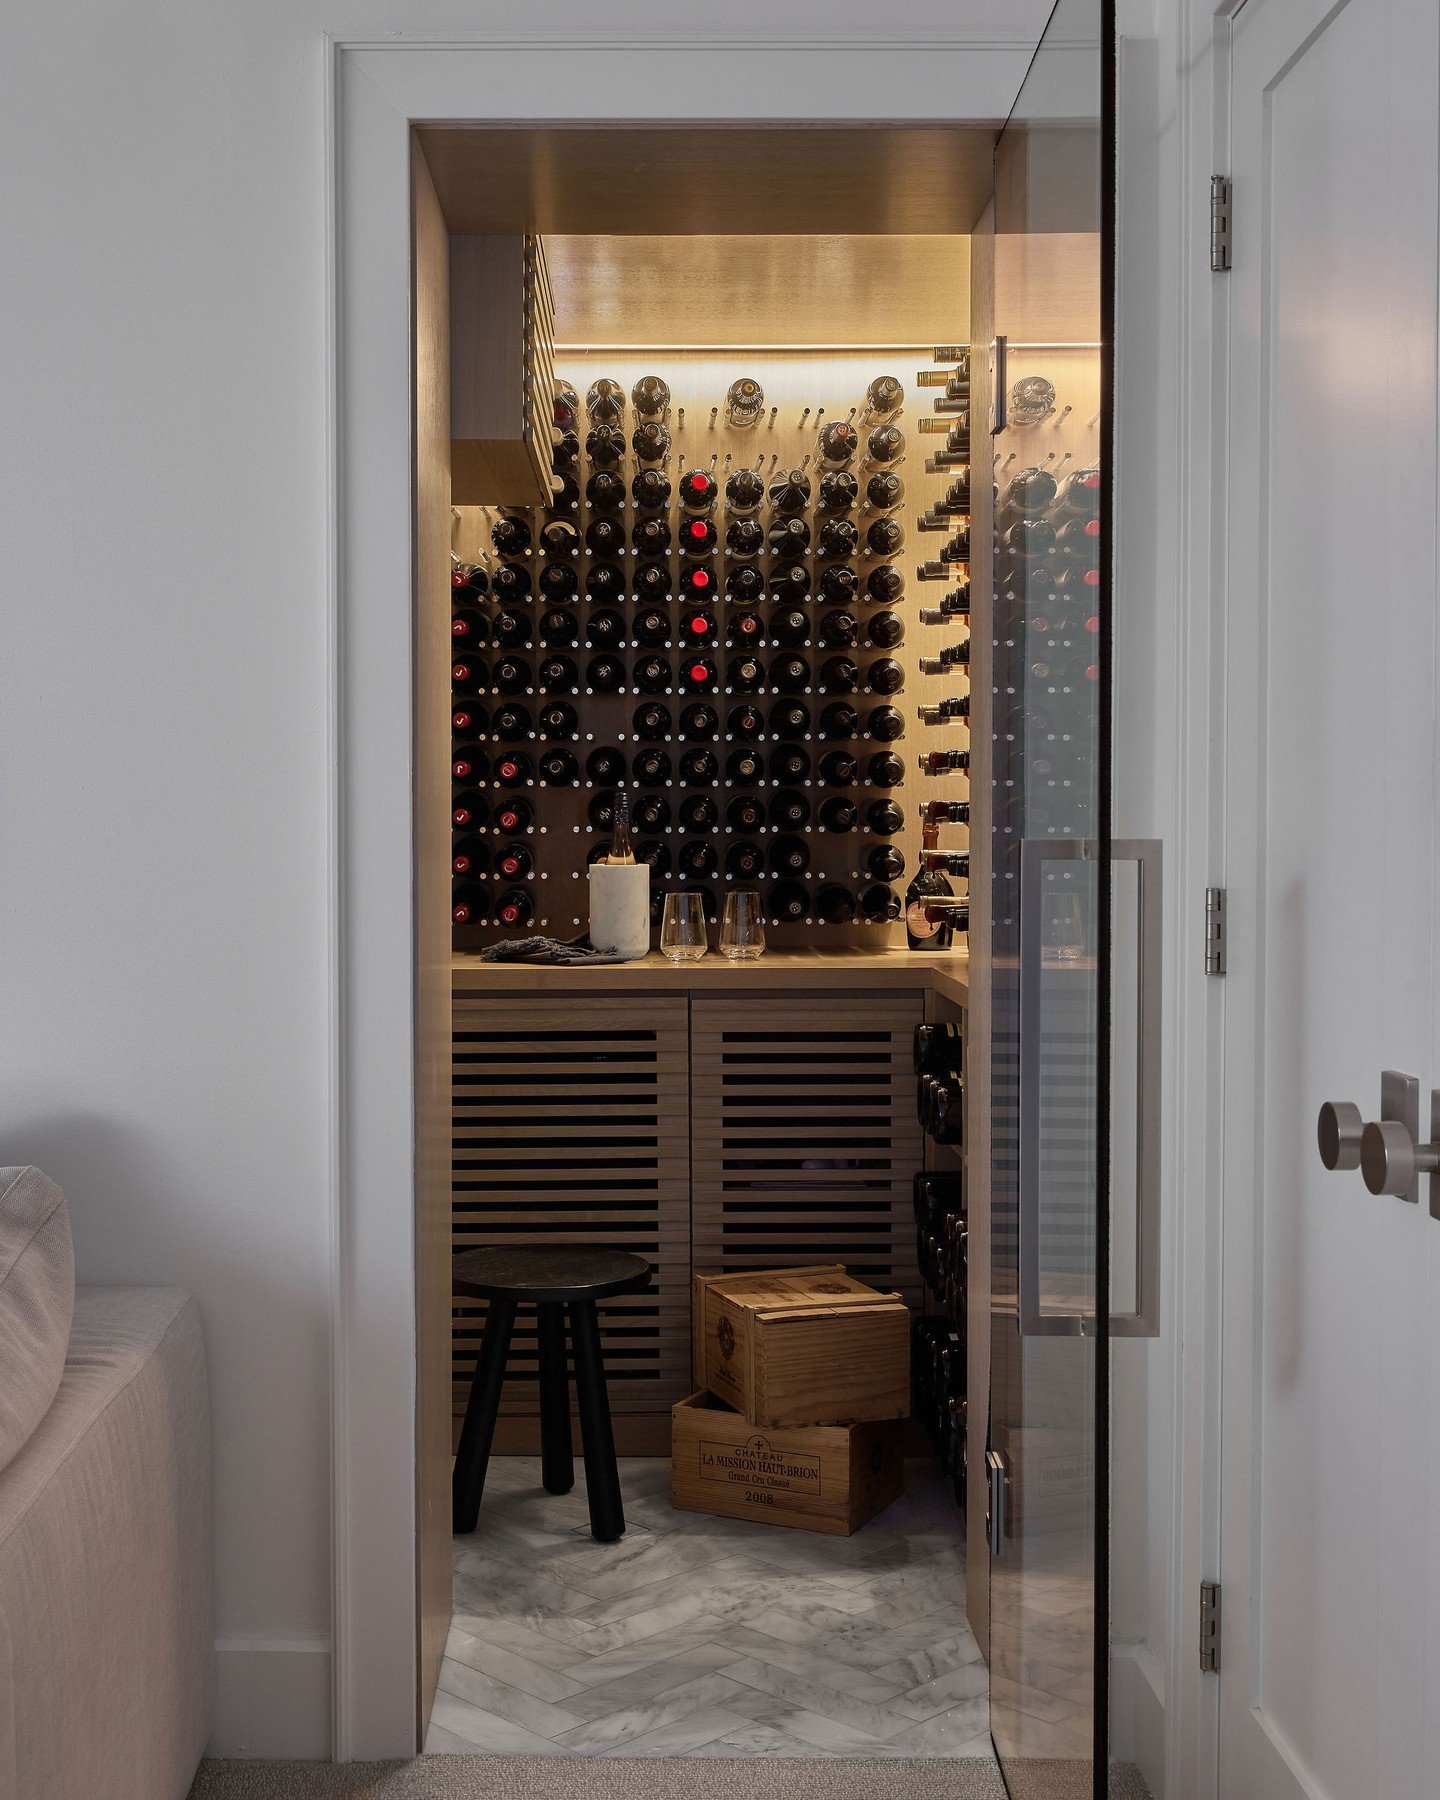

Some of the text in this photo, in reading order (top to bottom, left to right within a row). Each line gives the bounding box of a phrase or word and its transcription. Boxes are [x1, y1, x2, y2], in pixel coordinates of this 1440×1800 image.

[702, 1453, 714, 1465] LA
[716, 1455, 756, 1471] MISSION
[735, 1448, 783, 1461] CHATEAU
[728, 1470, 790, 1488] Grand Cru Classé
[745, 1491, 774, 1505] 2008
